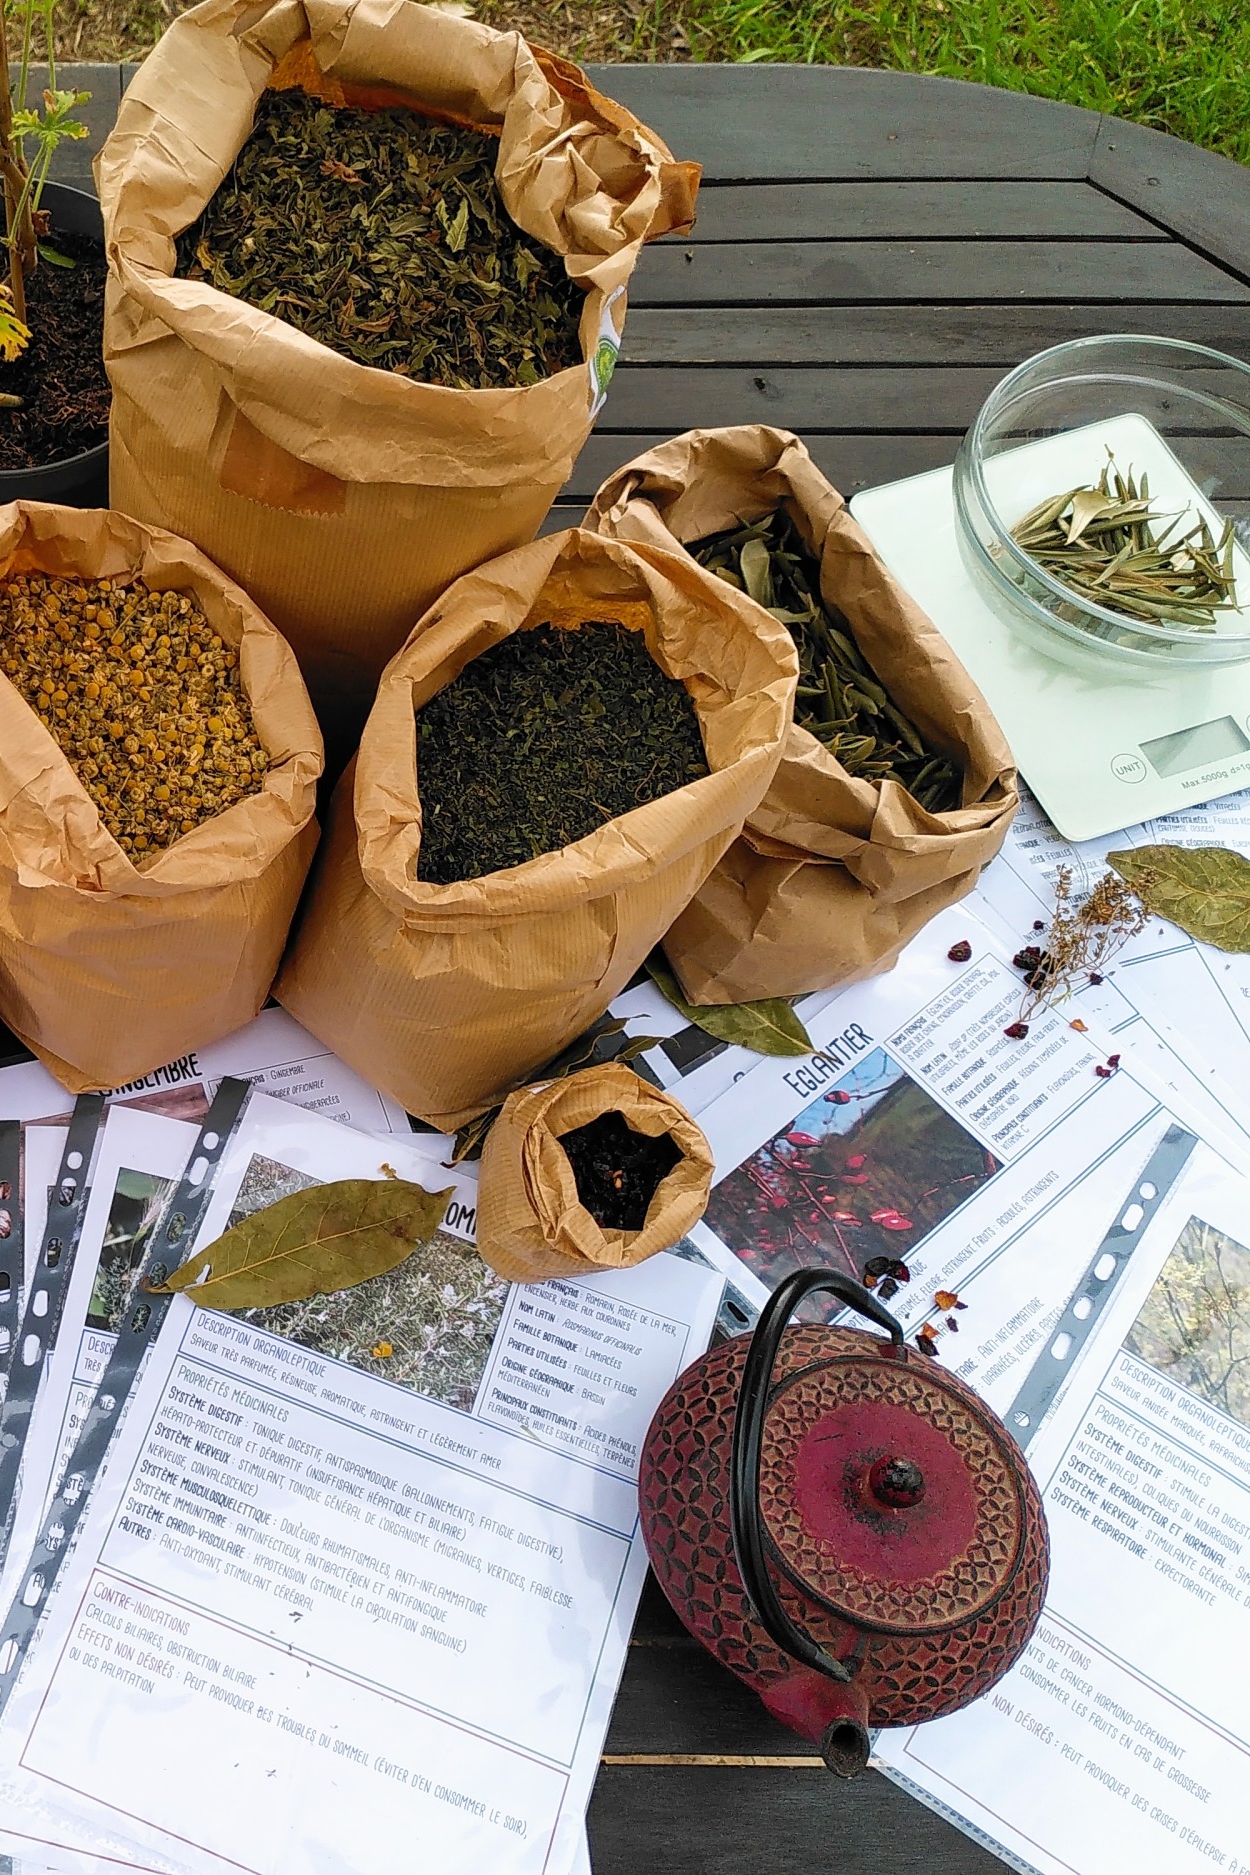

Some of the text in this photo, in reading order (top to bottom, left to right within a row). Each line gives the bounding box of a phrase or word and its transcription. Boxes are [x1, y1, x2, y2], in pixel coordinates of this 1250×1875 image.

[1116, 761, 1141, 777] UNIT
[783, 1022, 875, 1100] EGLANTIER
[167, 1385, 207, 1412] SYSTÈME
[416, 1427, 428, 1439] ET
[154, 1421, 193, 1449] SYSTÈME
[364, 1511, 376, 1526] DE
[1050, 1486, 1091, 1521] SYSTÈME
[1067, 1454, 1108, 1488] SYSTÈME
[1168, 1522, 1183, 1536] ET
[1083, 1422, 1125, 1455] SYSTÈME
[1206, 1503, 1220, 1518] LA
[1179, 1507, 1194, 1522] DU
[113, 1641, 136, 1661] NON
[317, 1732, 331, 1749] DU
[488, 1808, 501, 1824] LE
[991, 1693, 1015, 1716] NON
[1130, 1793, 1149, 1812] DES
[1070, 1699, 1088, 1718] LES
[1118, 1733, 1133, 1749] EN
[1133, 1743, 1152, 1763] CAS
[1152, 1756, 1166, 1773] DE
